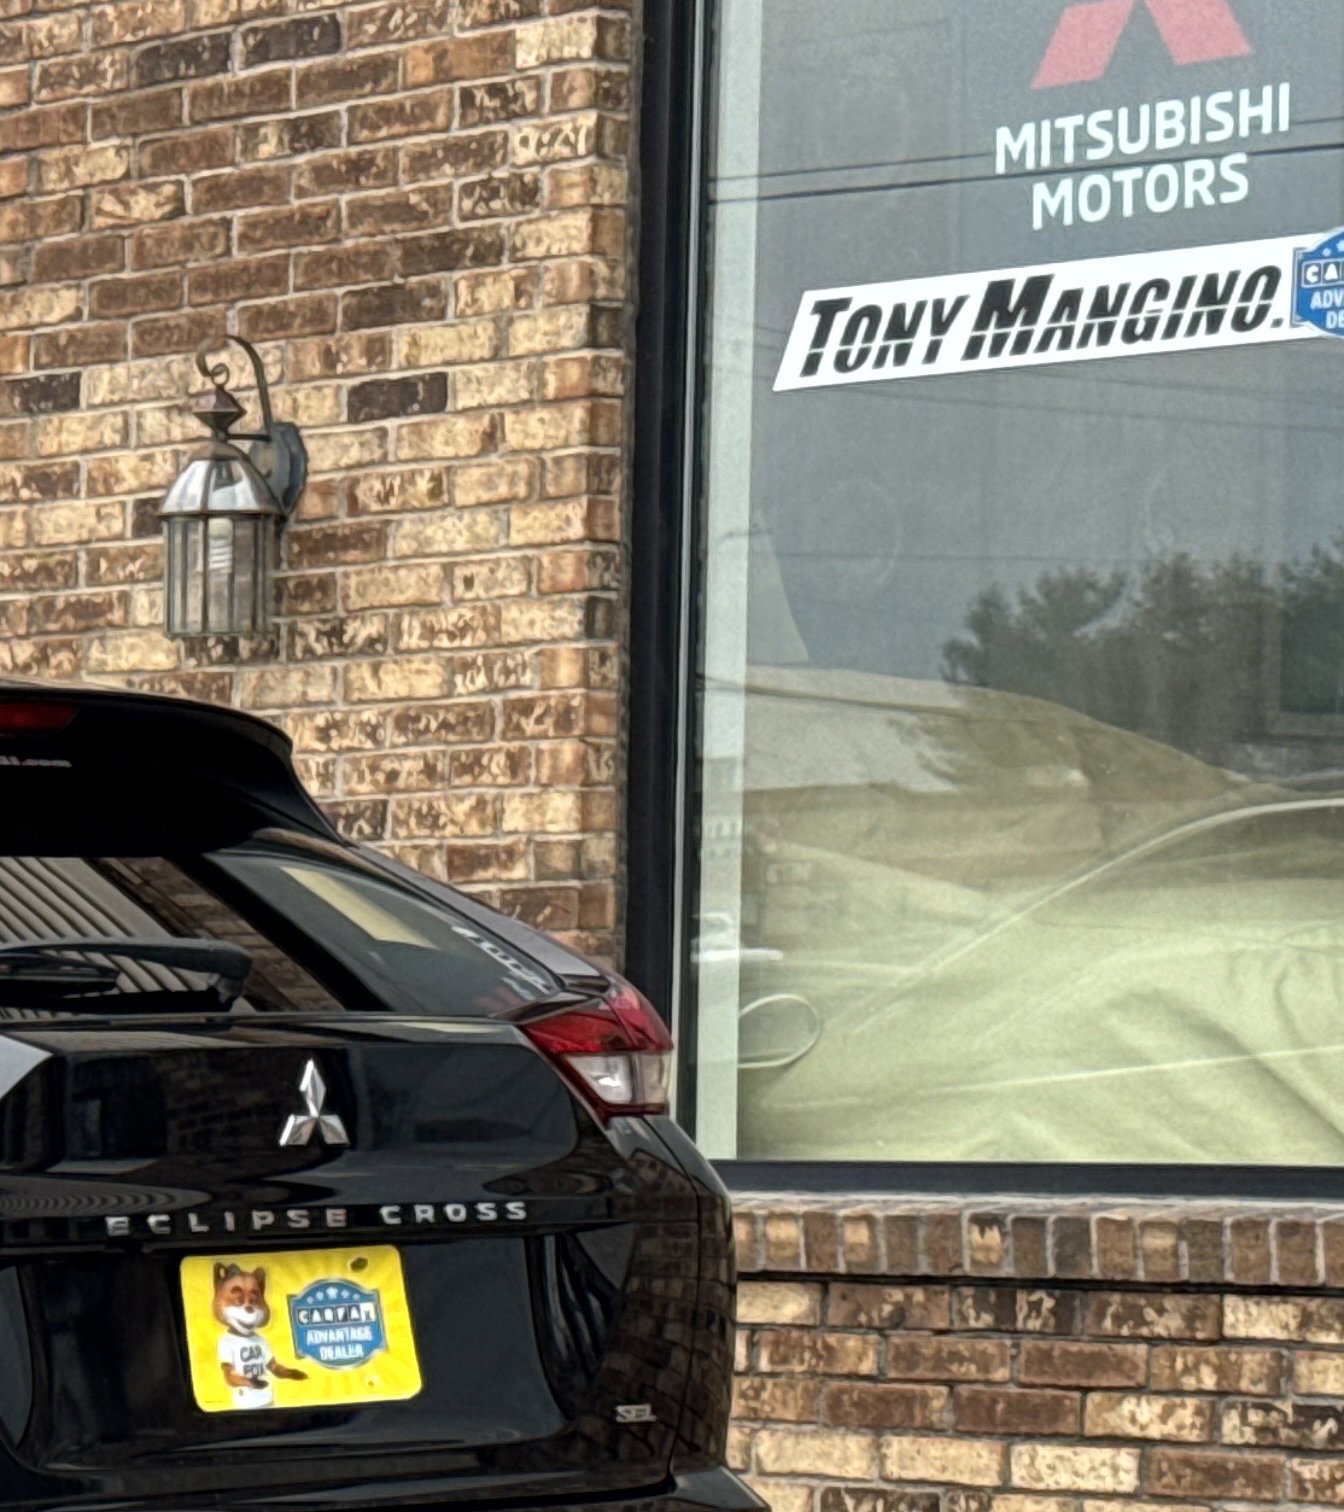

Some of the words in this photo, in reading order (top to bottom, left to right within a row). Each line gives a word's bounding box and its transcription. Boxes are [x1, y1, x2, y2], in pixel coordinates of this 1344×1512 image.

[995, 82, 1290, 175] MITSUBISHI
[1032, 152, 1249, 230] MOTORS
[800, 295, 970, 378] TONY
[106, 1208, 348, 1236] ECLIPSE
[378, 1201, 528, 1226] CROSS
[298, 1304, 376, 1324] CARFAX
[306, 1326, 373, 1346] ADVANTAGE
[239, 1344, 263, 1362] CAR
[319, 1343, 363, 1361] DEALER
